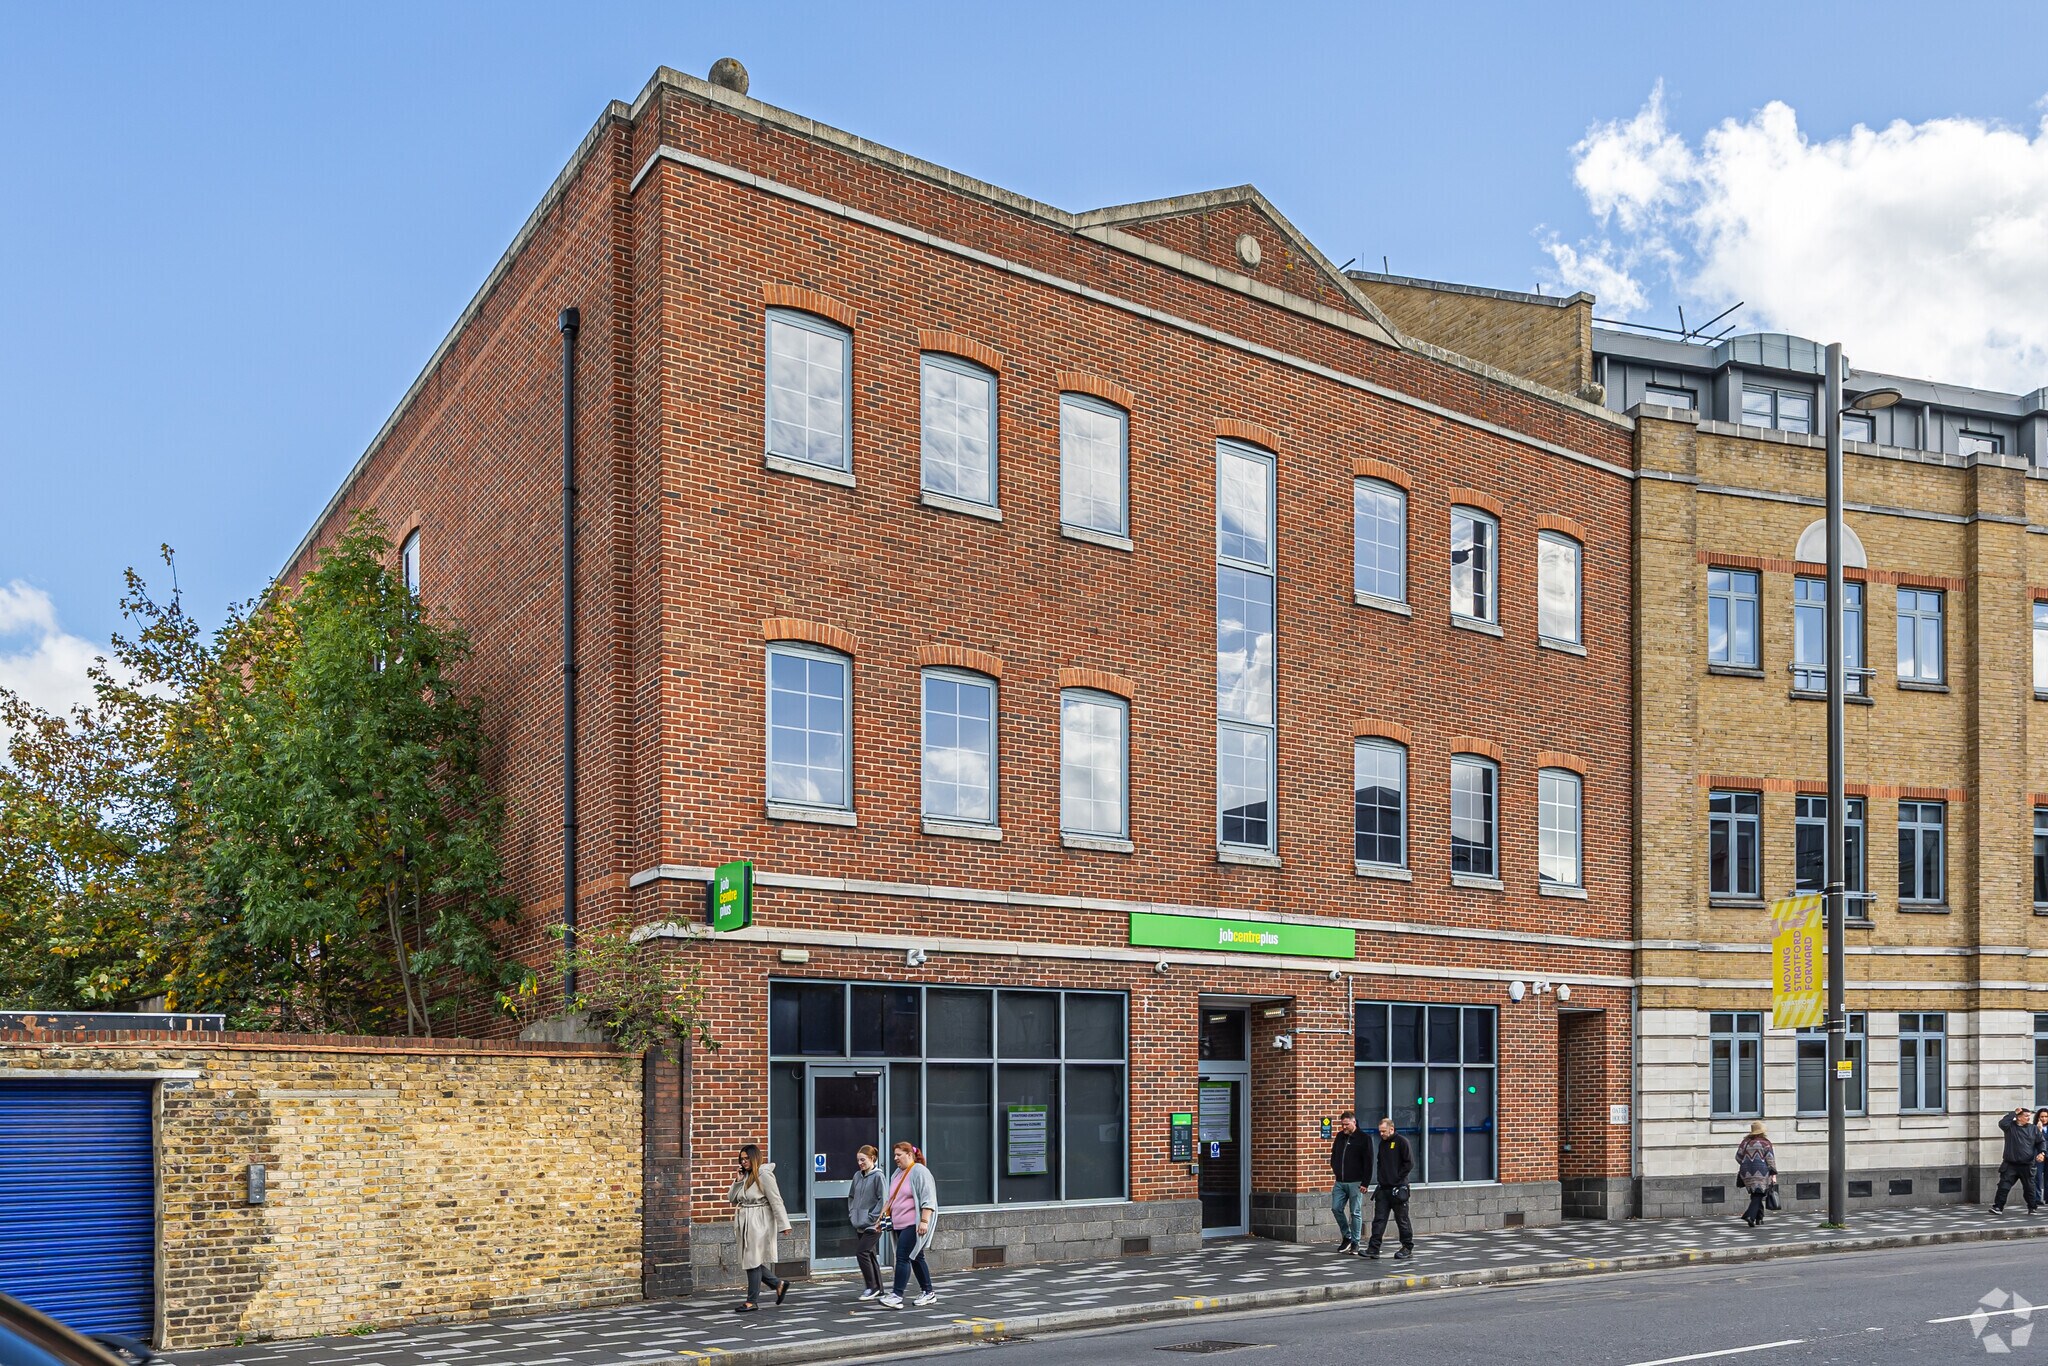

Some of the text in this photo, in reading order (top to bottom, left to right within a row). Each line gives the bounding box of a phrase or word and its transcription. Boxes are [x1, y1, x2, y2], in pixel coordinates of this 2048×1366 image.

[719, 876, 730, 894] job
[719, 889, 738, 904] centre
[719, 903, 732, 920] plus
[1218, 927, 1279, 947] jobcentreplus
[1782, 946, 1792, 993] MOVING
[1793, 930, 1802, 992] STRATFORD
[1803, 936, 1813, 991] FORWARD
